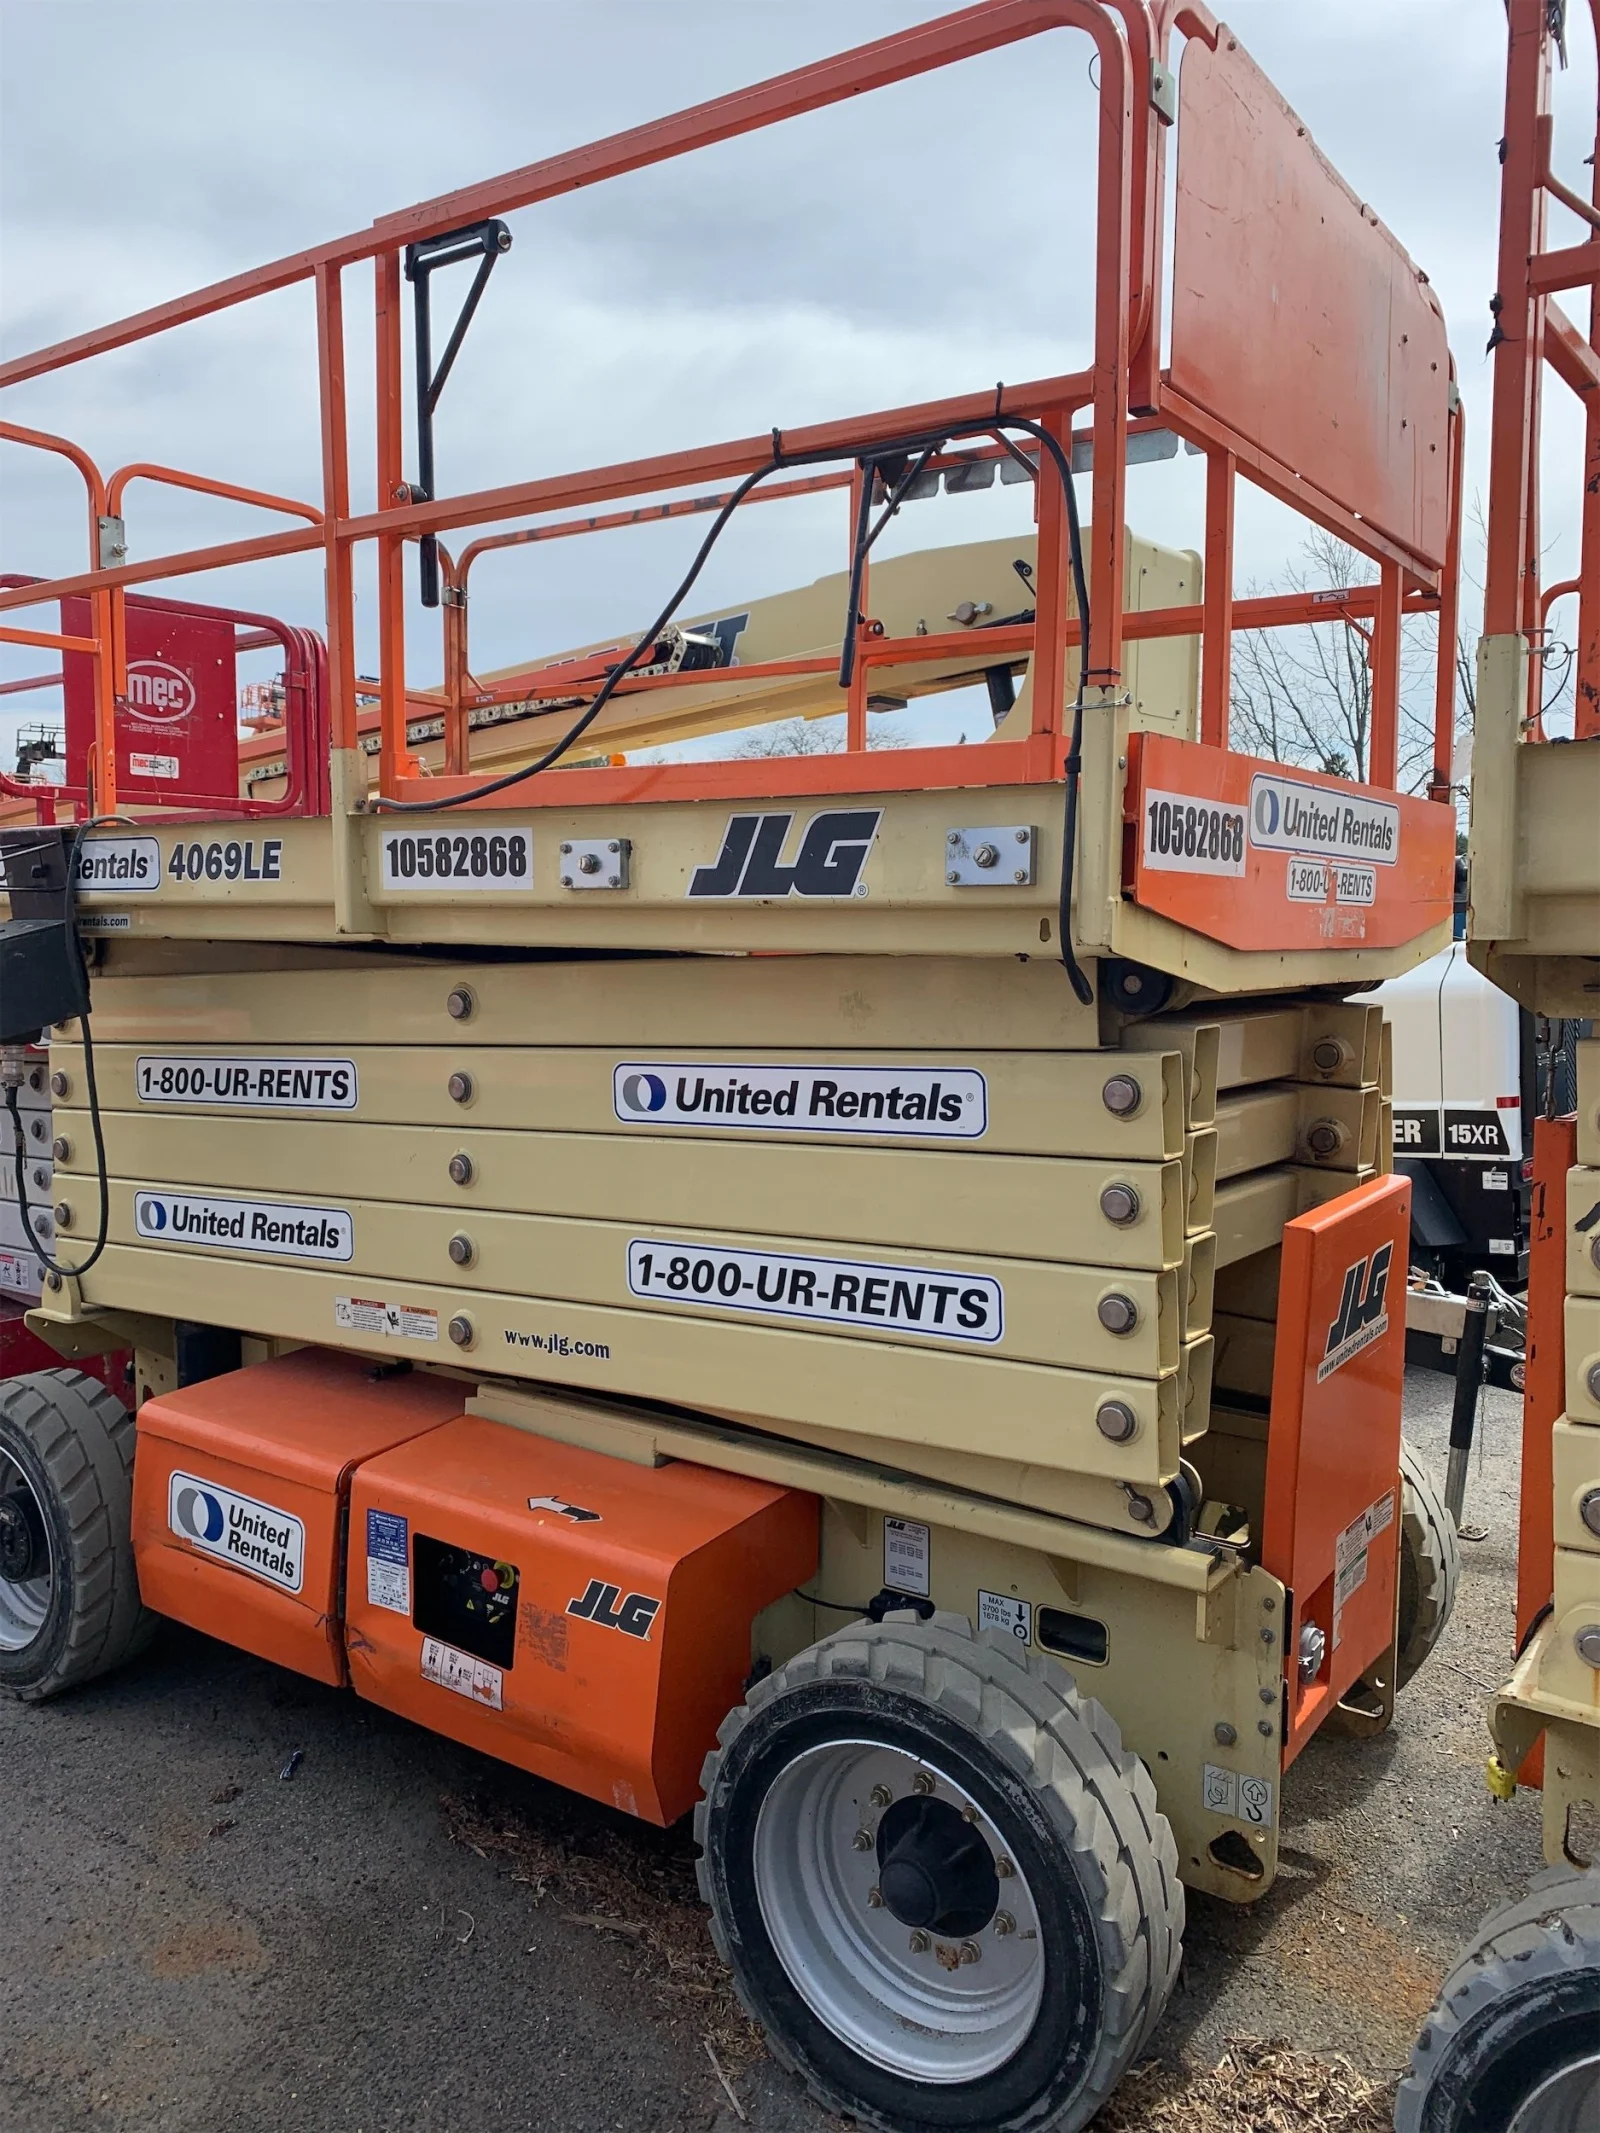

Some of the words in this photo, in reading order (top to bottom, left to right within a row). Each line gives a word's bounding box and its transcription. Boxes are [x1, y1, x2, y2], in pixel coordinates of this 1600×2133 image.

[127, 673, 183, 708] mec
[1148, 801, 1244, 863] 10582868
[1283, 796, 1337, 843] United
[1341, 807, 1393, 851] Rentals
[168, 841, 282, 881] 4069LE
[386, 836, 527, 878] 10582868
[687, 810, 882, 897] JLG
[1291, 867, 1373, 898] 1-800-U-RENTS
[141, 1066, 350, 1101] 1-800-UR-RENTS
[675, 1077, 800, 1117] United
[808, 1079, 963, 1122] Rentals
[1392, 1119, 1422, 1143] ER
[1447, 1124, 1499, 1145] 15XR
[171, 1203, 245, 1239] United
[250, 1212, 340, 1249] Rentals
[637, 1253, 990, 1329] 1-800-UR-RENTS
[1325, 1241, 1393, 1357] JLG
[504, 1329, 611, 1360] www.jlg.com
[228, 1504, 291, 1550] United
[227, 1530, 295, 1579] Rentals
[566, 1579, 661, 1638] JLG
[982, 1603, 1000, 1614] 3700
[1000, 1608, 1011, 1618] lbs
[988, 1596, 1005, 1607] MAX
[1000, 1616, 1010, 1626] kg
